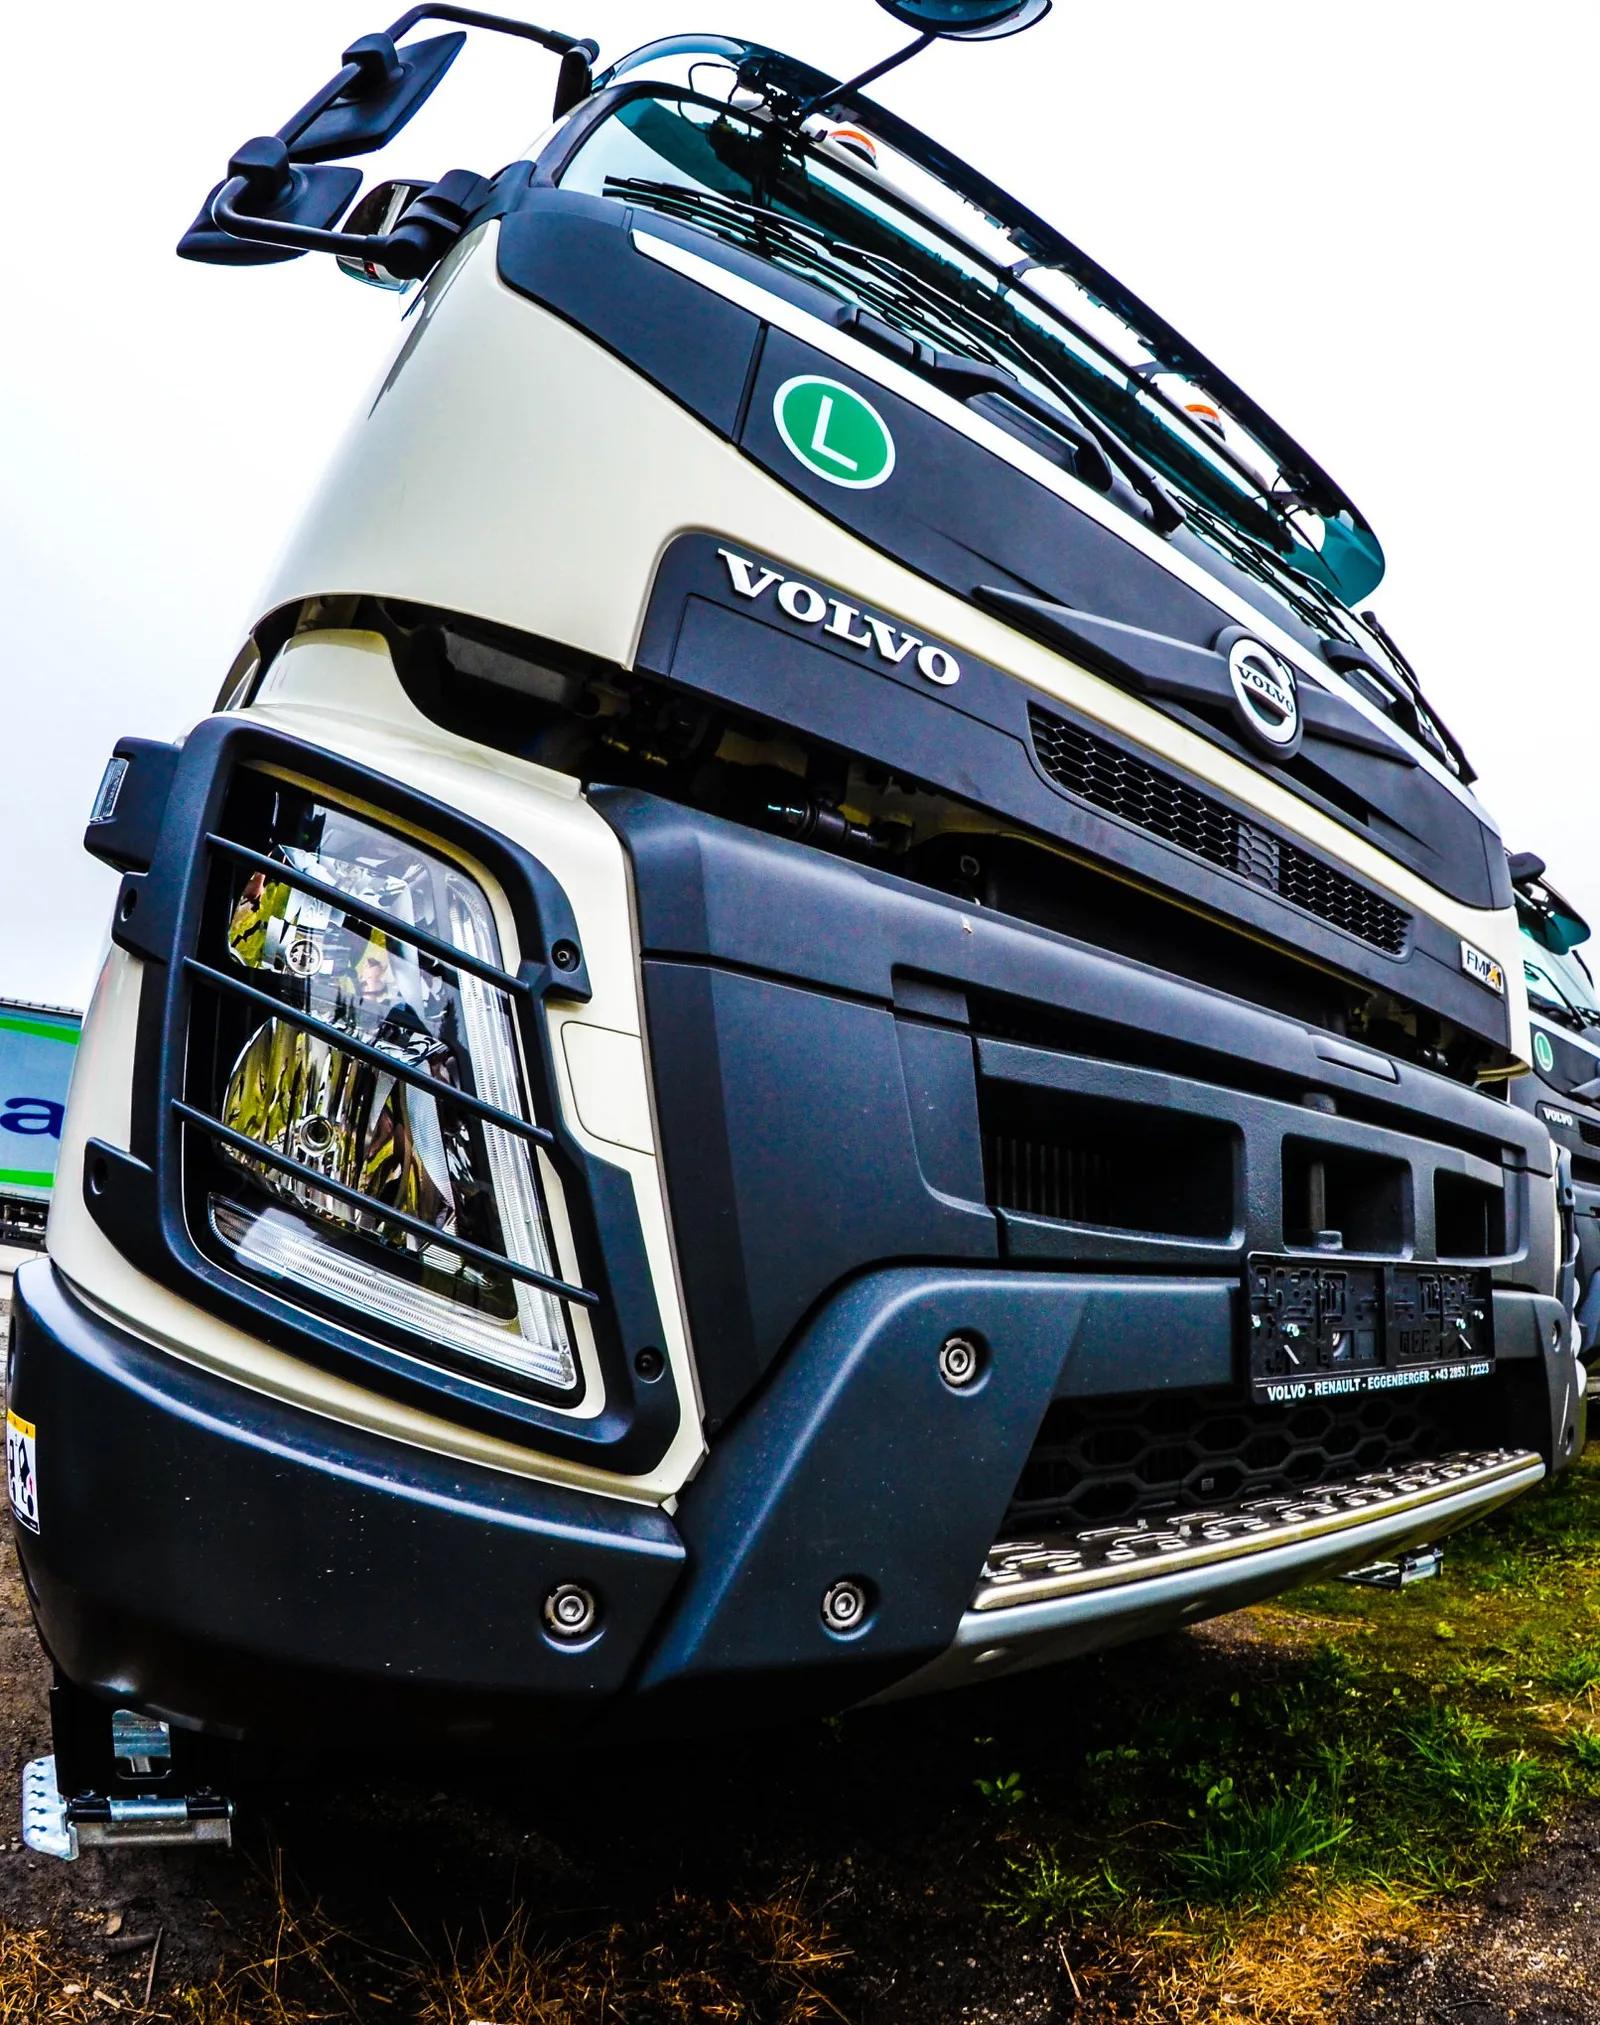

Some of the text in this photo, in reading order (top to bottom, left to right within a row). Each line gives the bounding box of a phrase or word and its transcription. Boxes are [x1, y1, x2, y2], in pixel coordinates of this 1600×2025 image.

[811, 394, 858, 472] L
[717, 547, 961, 686] VOLVO
[1234, 663, 1294, 714] VOLVO
[1542, 1107, 1573, 1127] VOLVO
[1267, 1383, 1306, 1401] VOLVO
[1314, 1377, 1361, 1396] RENAULT
[1367, 1370, 1430, 1390] EGGENBERGER
[1434, 1367, 1449, 1380] +43
[1449, 1365, 1466, 1379] 2853
[1469, 1362, 1490, 1376] 72323
